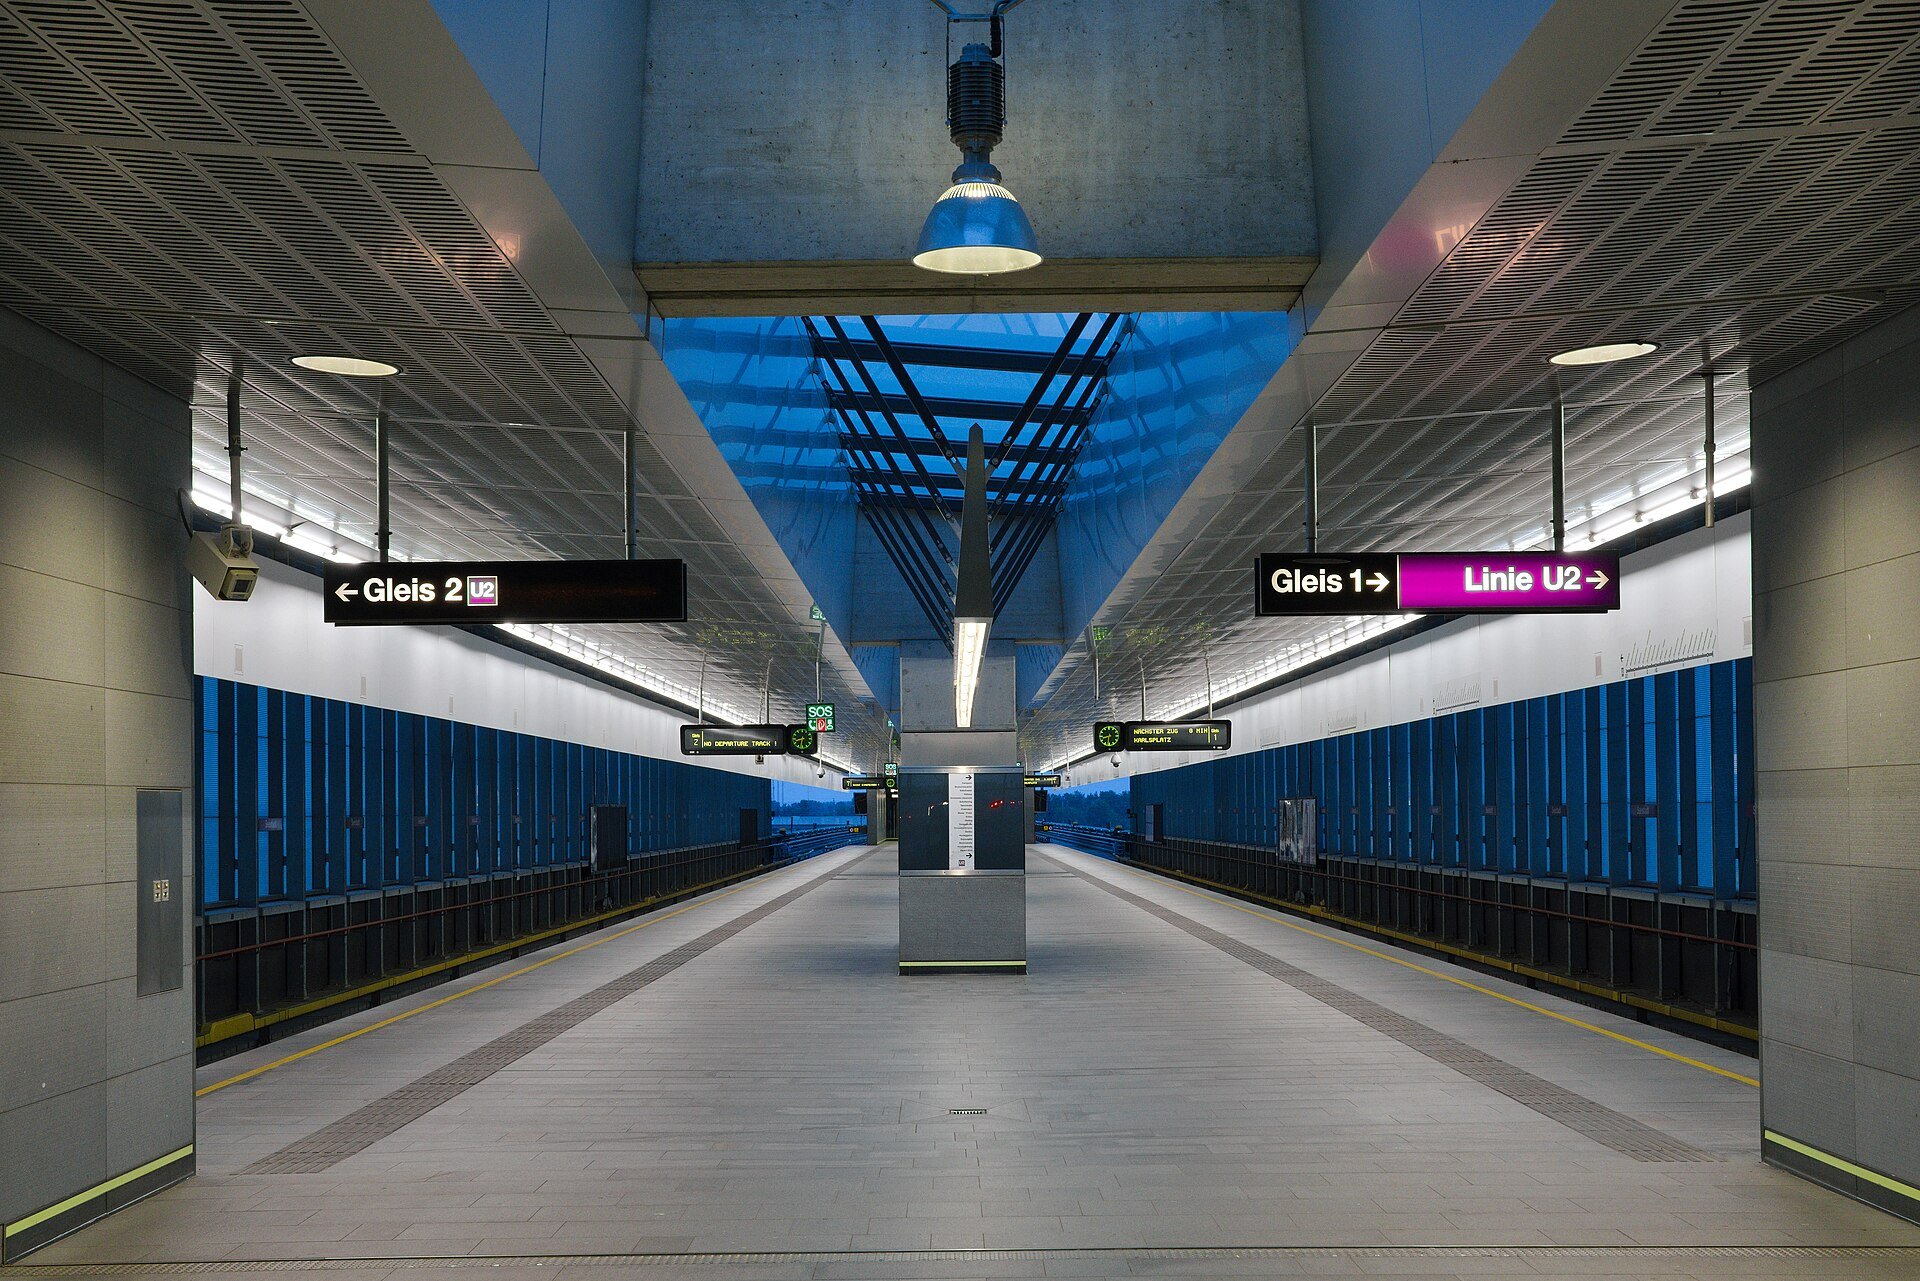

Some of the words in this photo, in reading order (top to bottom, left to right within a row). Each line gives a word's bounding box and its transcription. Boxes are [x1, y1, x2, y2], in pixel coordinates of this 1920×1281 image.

[1271, 569, 1343, 593] Gleis
[1350, 569, 1362, 592] 1
[1464, 566, 1533, 592] Linie
[1543, 566, 1582, 591] U2
[363, 577, 436, 602] Gleis
[444, 577, 463, 601] 2
[470, 581, 495, 598] U2
[808, 706, 833, 717] SOS
[693, 738, 699, 746] 2
